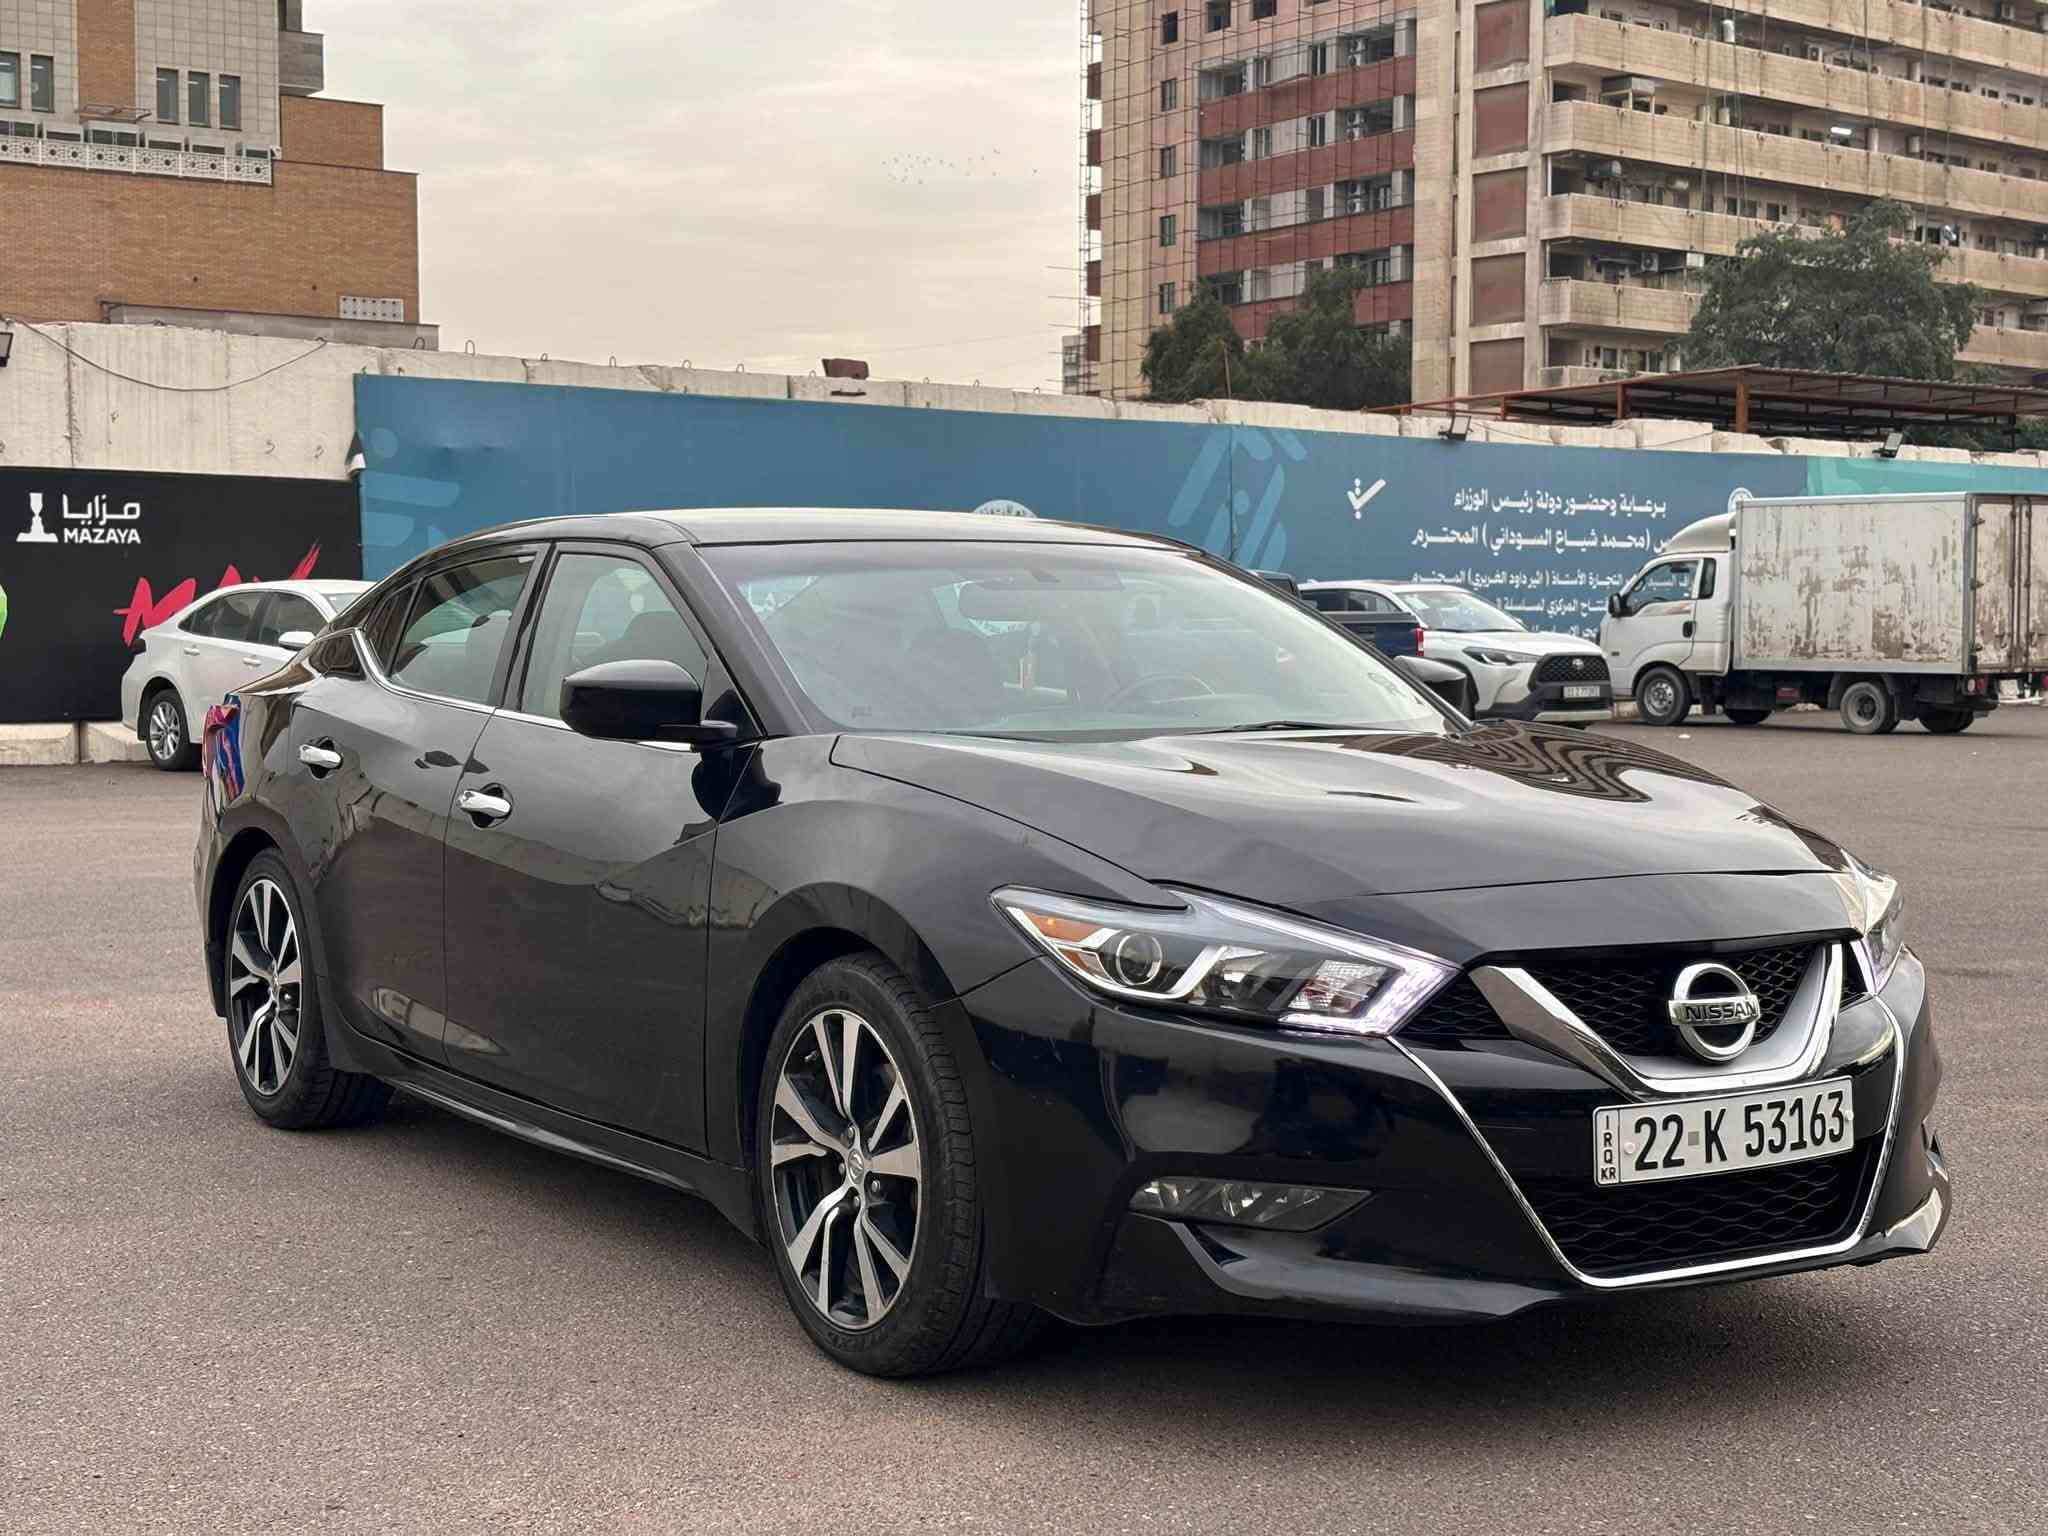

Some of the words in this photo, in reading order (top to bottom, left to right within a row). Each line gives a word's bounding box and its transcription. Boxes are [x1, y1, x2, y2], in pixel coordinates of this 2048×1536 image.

[63, 494, 141, 526] مزايا
[1453, 487, 1489, 512] الوزراء
[1491, 489, 1534, 515] رئيس
[1536, 490, 1562, 515] دولة
[1564, 494, 1617, 516] وحضور
[1619, 494, 1667, 517] برعاية
[63, 527, 141, 544] MAZAYA
[1411, 524, 1479, 548] المحترم
[1685, 1000, 1757, 1021] NISSAN
[1635, 1114, 1685, 1171] 22
[1704, 1108, 1728, 1164] K
[1744, 1091, 1844, 1157] 53163
[1601, 1167, 1616, 1180] KR
